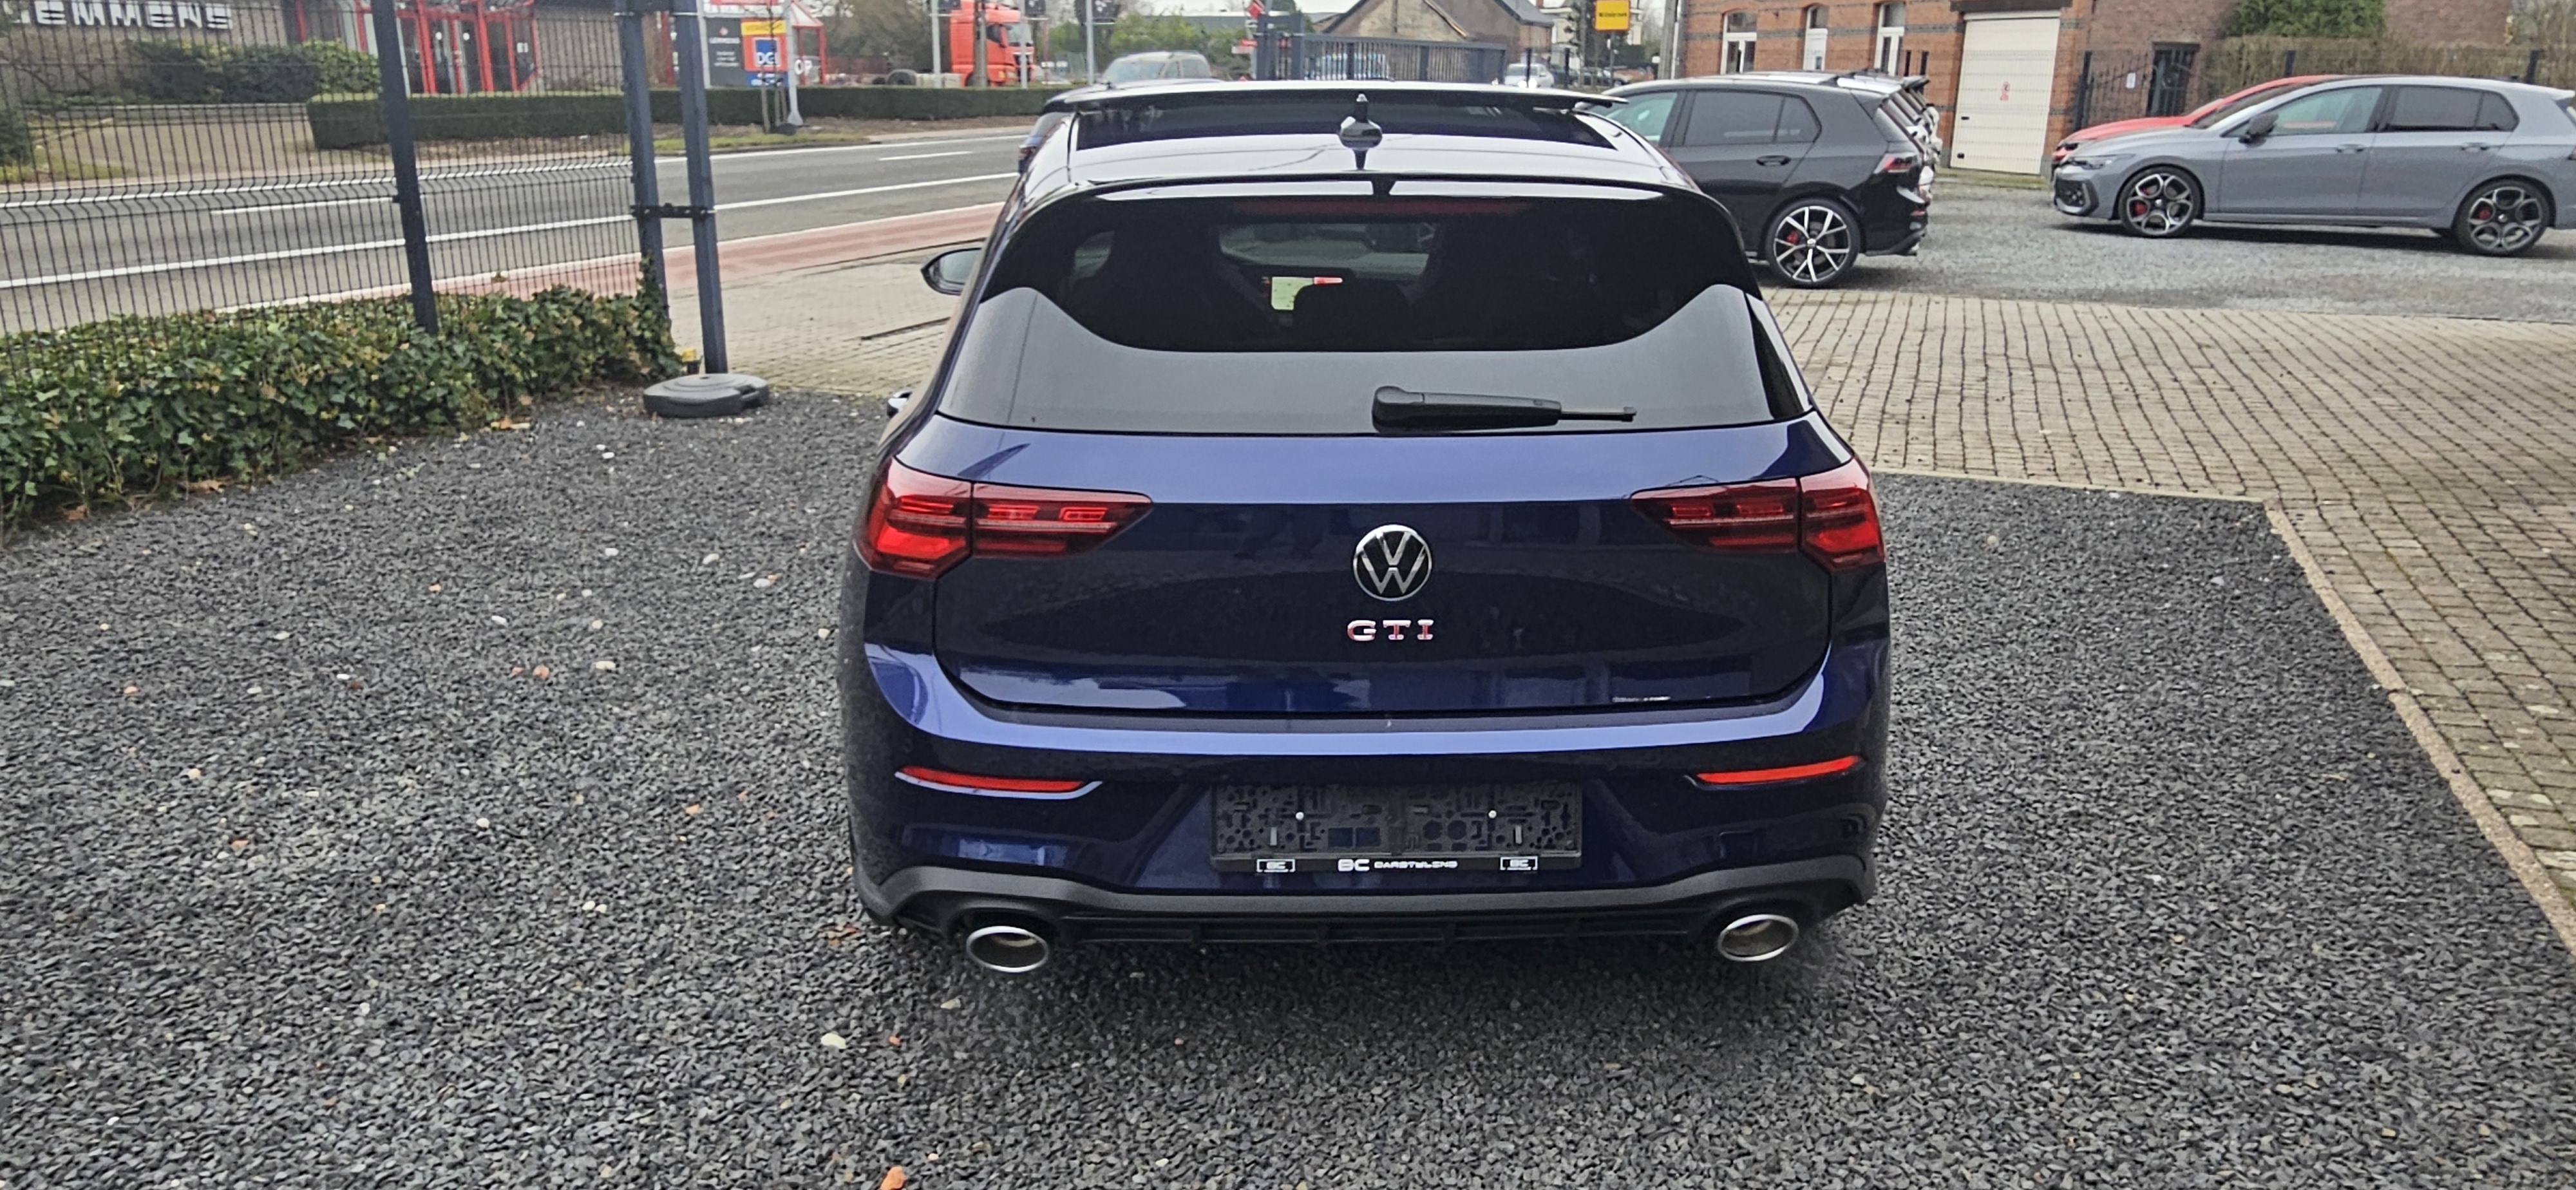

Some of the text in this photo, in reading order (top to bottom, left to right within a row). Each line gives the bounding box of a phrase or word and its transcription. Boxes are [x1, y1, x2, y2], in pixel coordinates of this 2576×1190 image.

[1356, 529, 1428, 594] VW
[1347, 619, 1434, 641] GTI
[1338, 858, 1370, 872] BC
